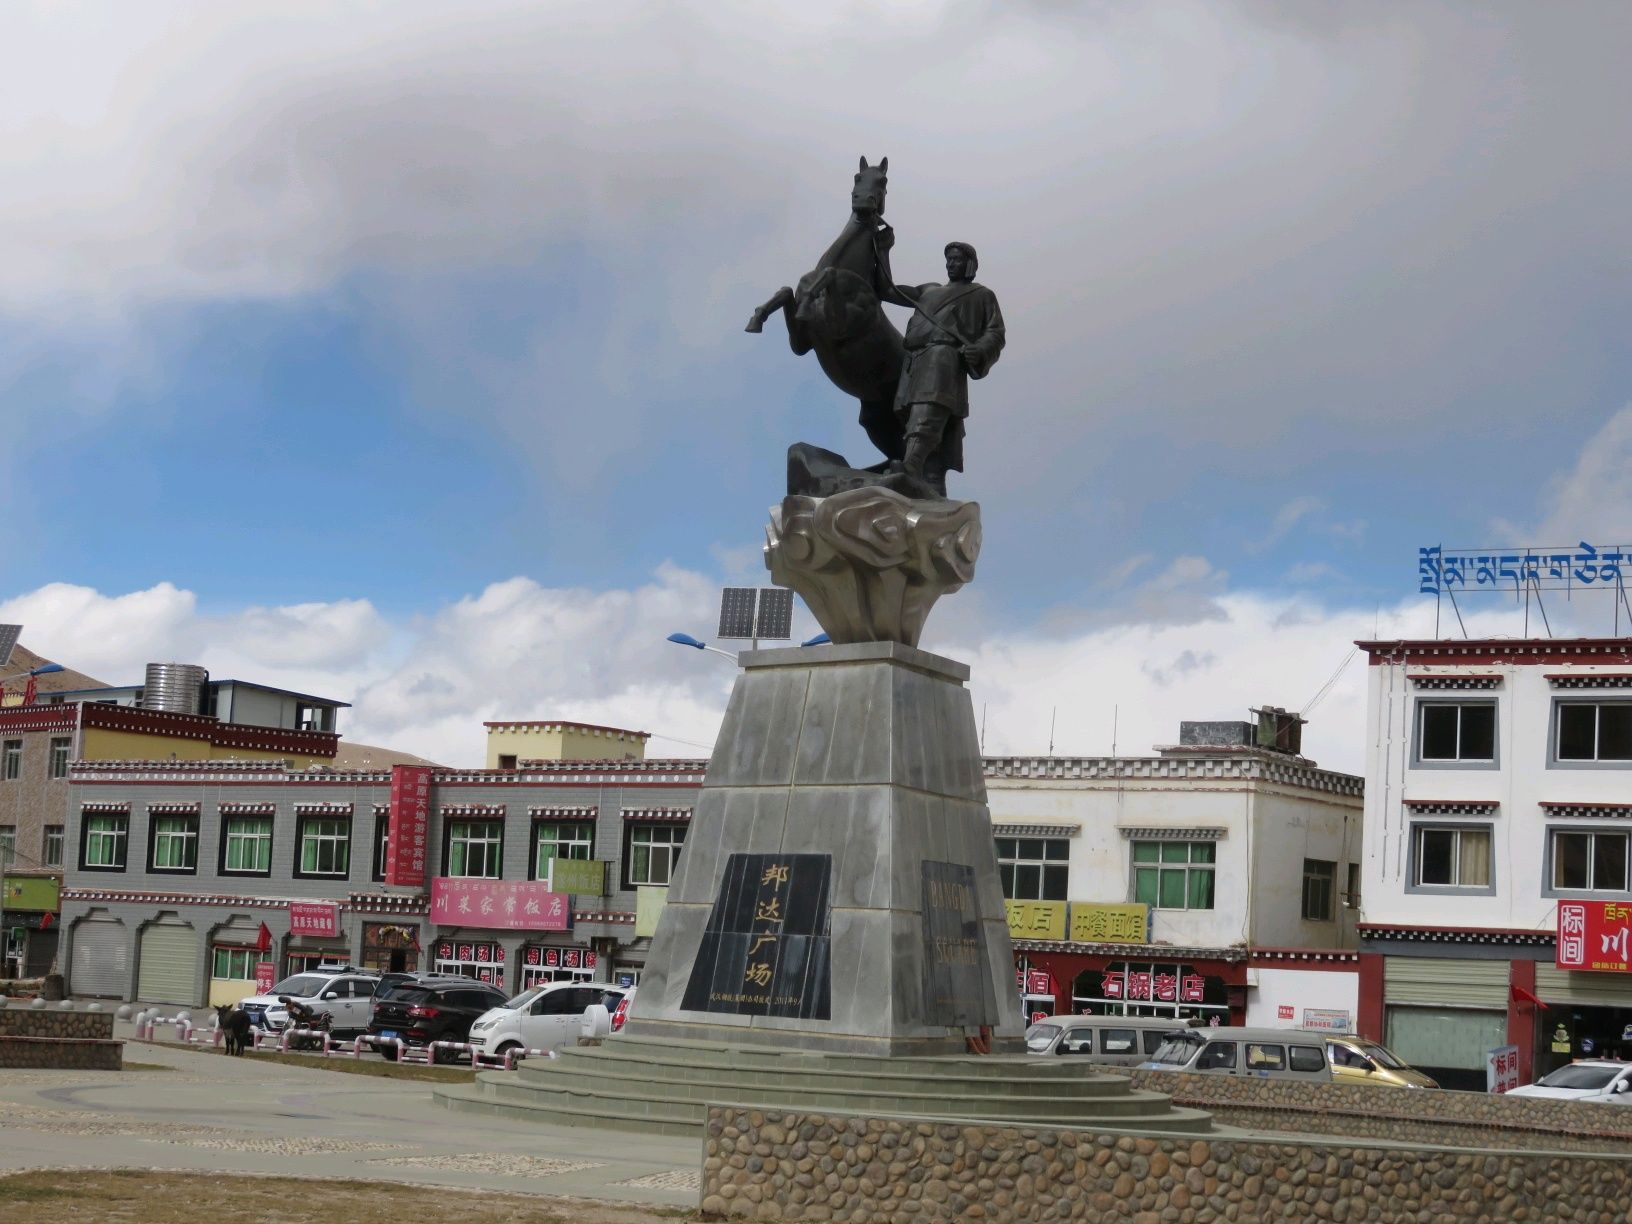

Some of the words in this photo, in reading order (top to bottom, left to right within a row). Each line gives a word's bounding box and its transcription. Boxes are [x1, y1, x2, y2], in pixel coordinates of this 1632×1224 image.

[411, 773, 429, 871] 高原天地游客宾馆
[436, 894, 562, 917] 川菜家常饭店
[930, 880, 972, 910] BANGDA
[745, 863, 790, 988] 邦达广场
[1562, 907, 1584, 962] 标间
[527, 947, 598, 969] 特色汤锅
[936, 936, 977, 965] SQUARE
[1600, 927, 1629, 962] 川
[1101, 971, 1205, 1001] 石锅老店
[1496, 1051, 1517, 1077] 标间
